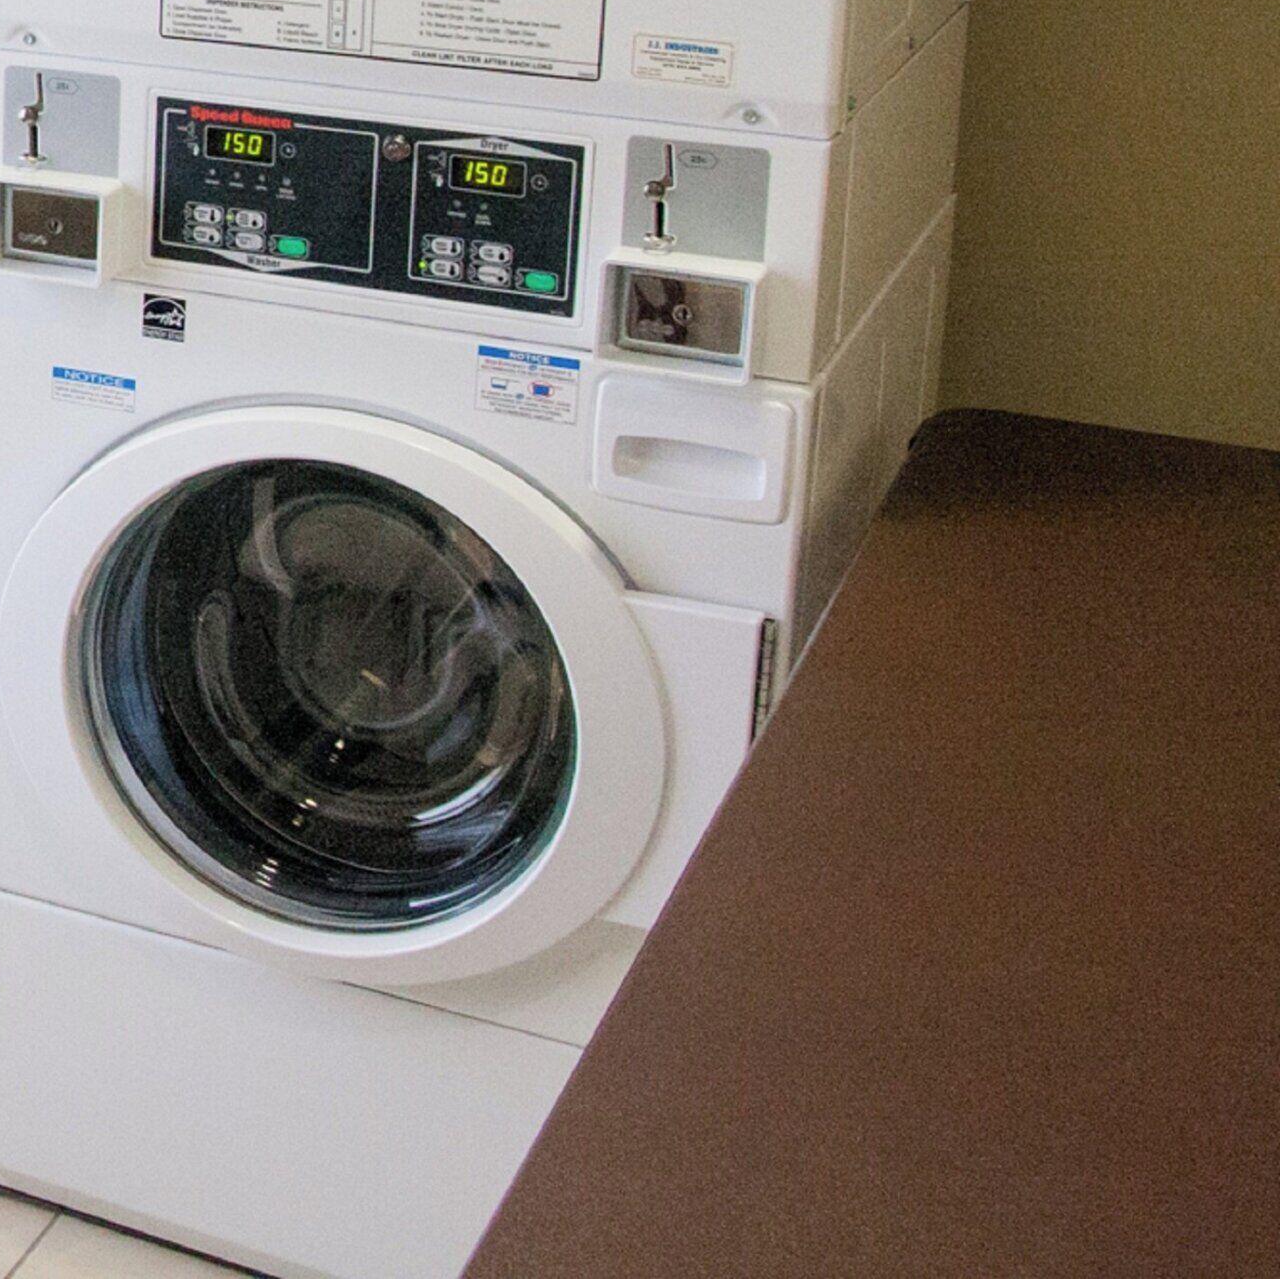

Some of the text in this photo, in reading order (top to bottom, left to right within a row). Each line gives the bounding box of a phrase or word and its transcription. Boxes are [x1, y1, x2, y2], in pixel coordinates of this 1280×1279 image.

[191, 106, 293, 129] Speed Queen
[224, 132, 263, 156] 150
[480, 139, 510, 151] Dryer
[464, 161, 508, 186] 150
[247, 255, 281, 267] Washer
[509, 351, 550, 364] NOTICE
[63, 369, 124, 387] NOTICE
